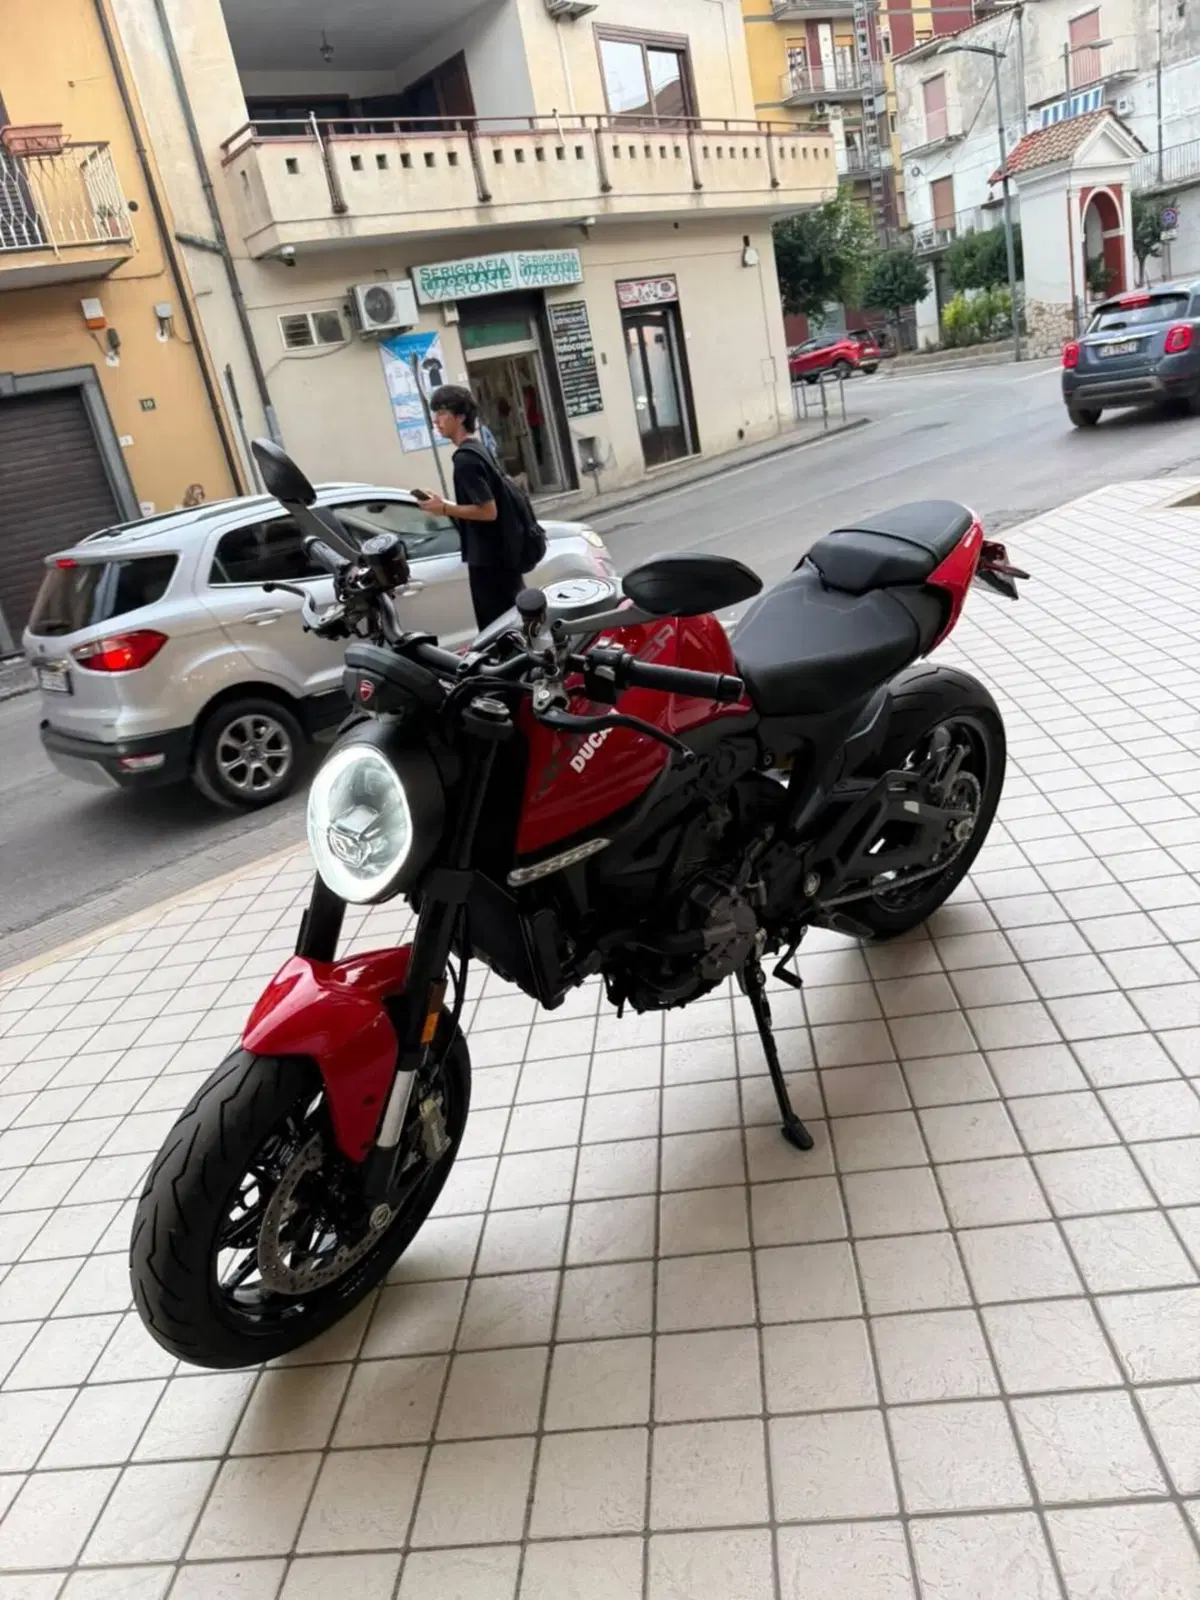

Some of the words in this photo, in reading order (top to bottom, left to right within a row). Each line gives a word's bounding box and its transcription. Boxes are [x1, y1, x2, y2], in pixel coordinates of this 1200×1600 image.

[419, 258, 509, 279] SERIGRAFIA
[518, 252, 577, 266] SERIGRAFIA
[422, 269, 511, 290] TIPOGRAFIA
[425, 279, 513, 300] VARONE
[521, 273, 581, 286] VARONE
[570, 708, 619, 773] DUCA
